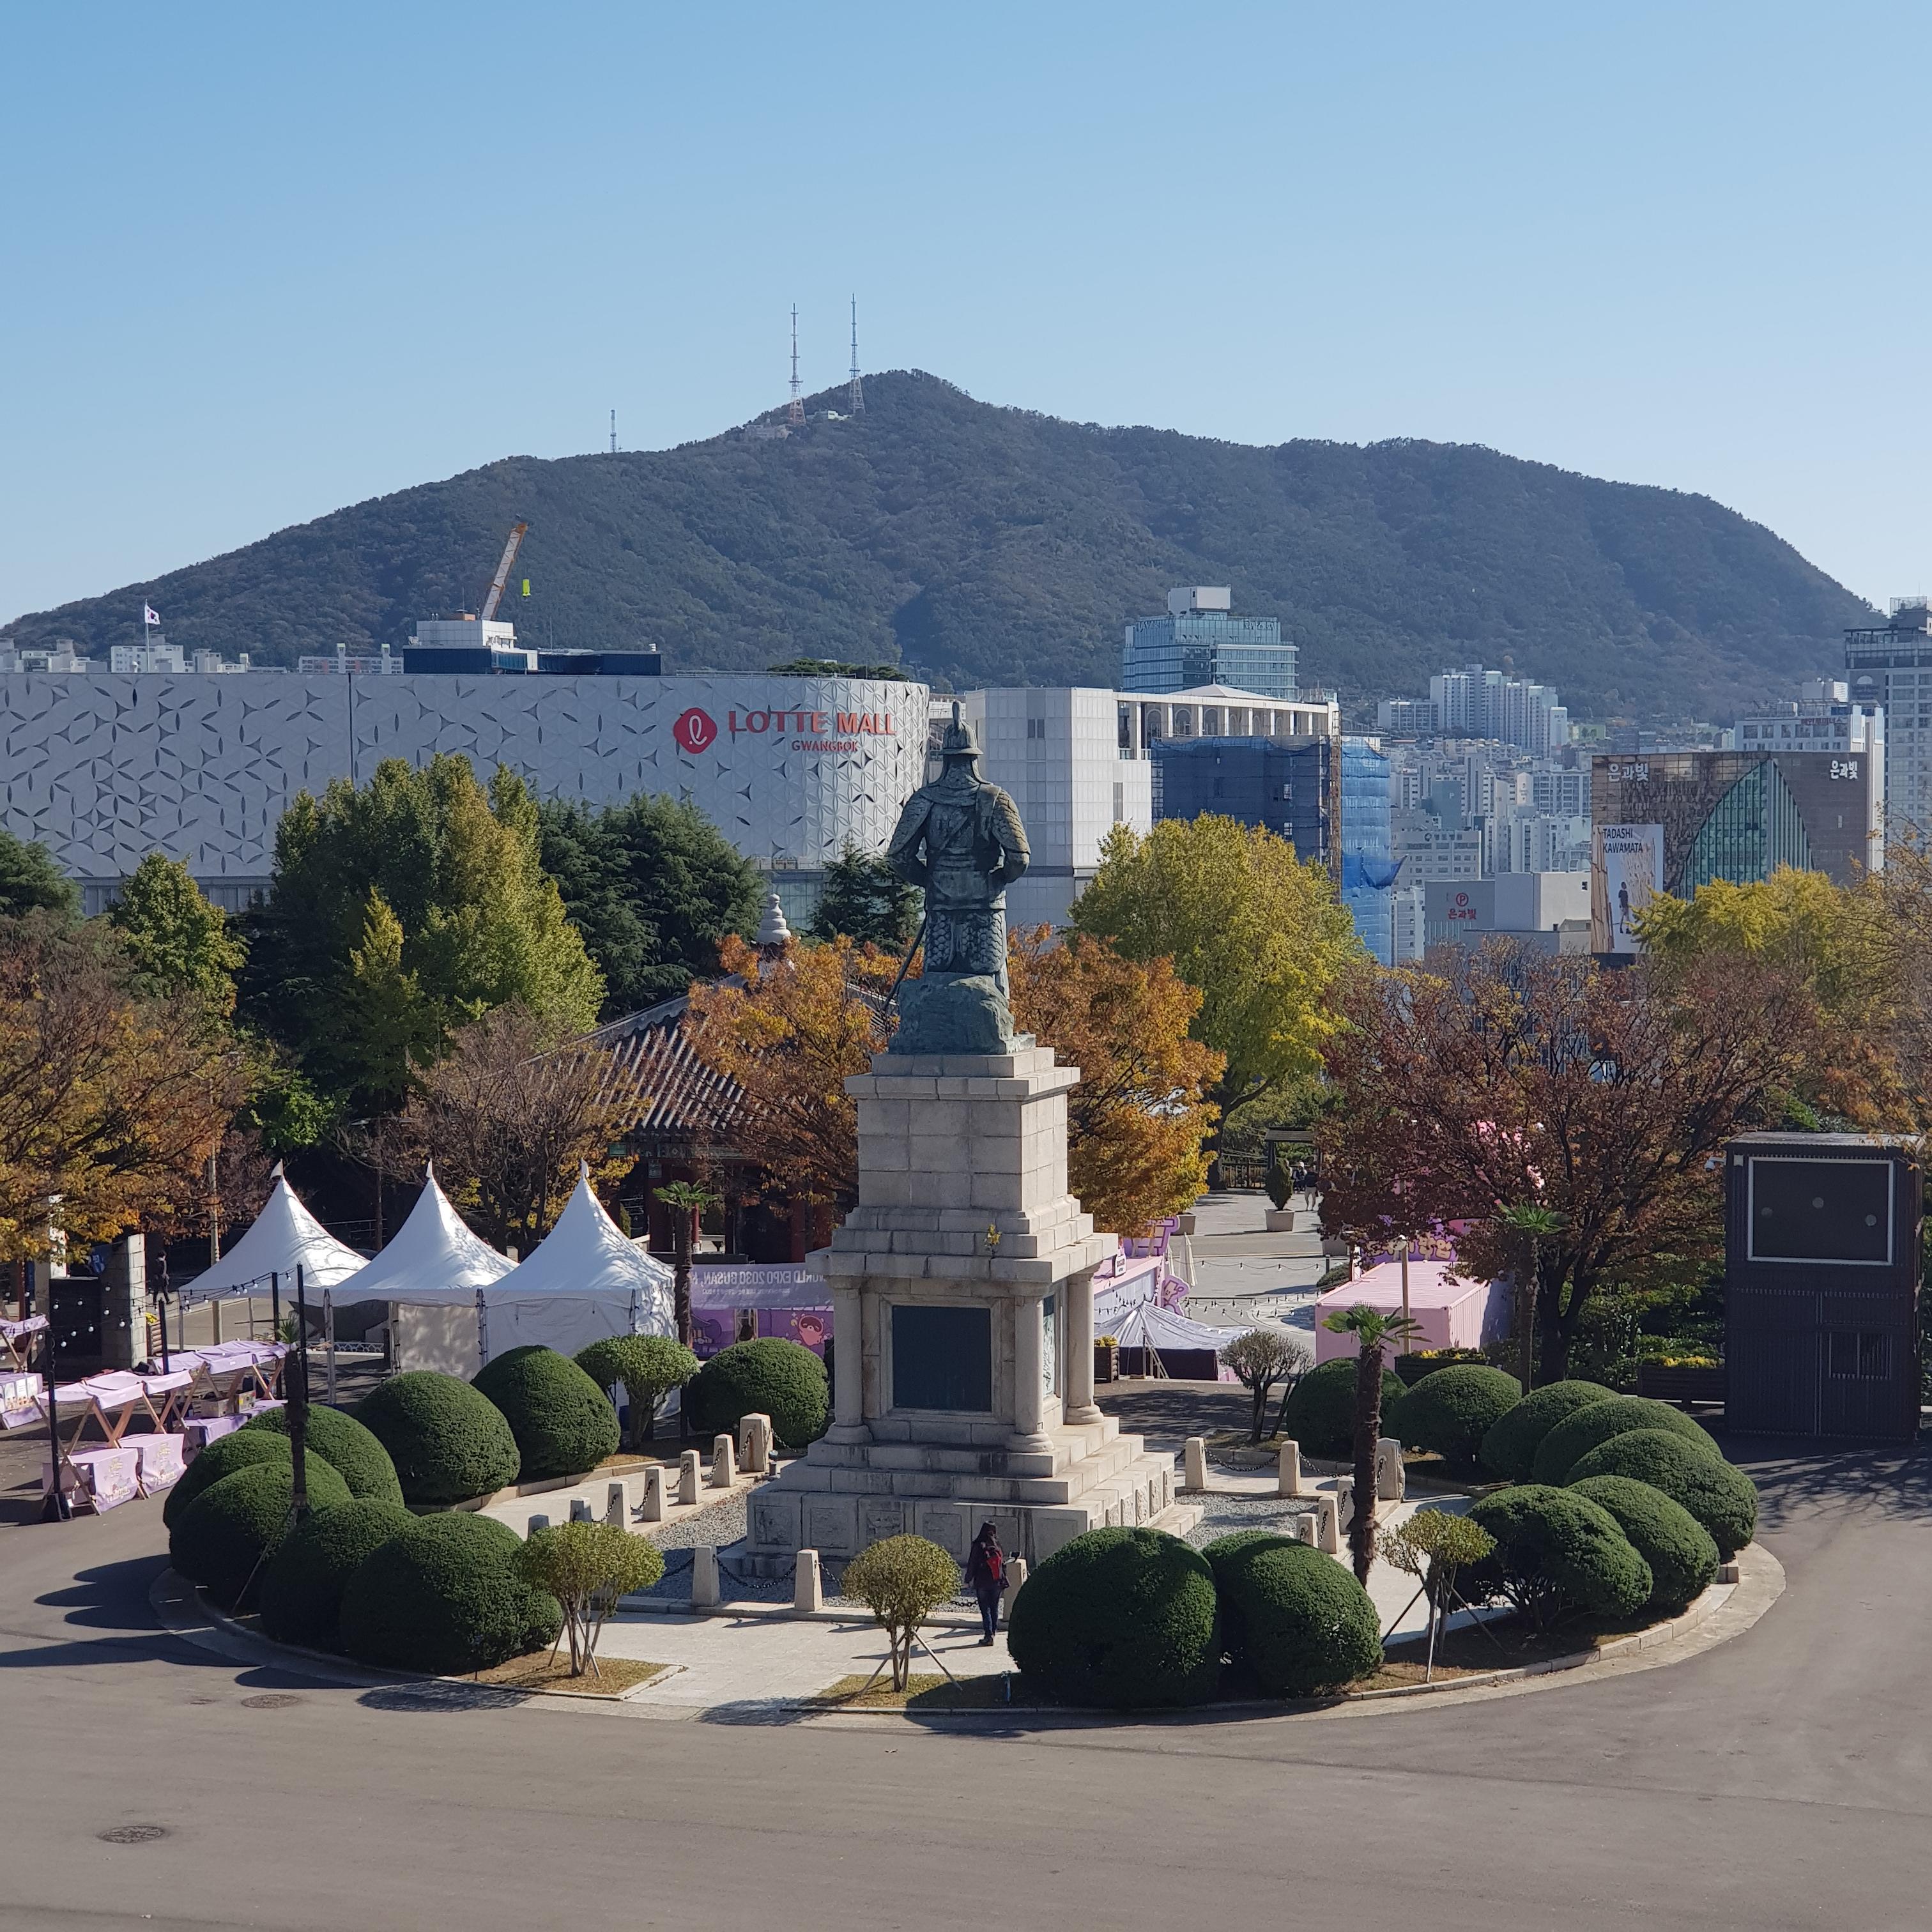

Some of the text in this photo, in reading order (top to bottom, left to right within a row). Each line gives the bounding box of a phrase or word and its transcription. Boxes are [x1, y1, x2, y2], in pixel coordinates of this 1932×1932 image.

[728, 710, 896, 735] LOTTE MALL
[792, 740, 858, 752] GWANGBOK
[1607, 763, 1648, 782] 은과빛
[1830, 760, 1858, 779] 은과빛
[1603, 828, 1633, 839] TADASHI
[1603, 843, 1643, 854] KAWAMATA
[1448, 908, 1476, 920] 은과빛
